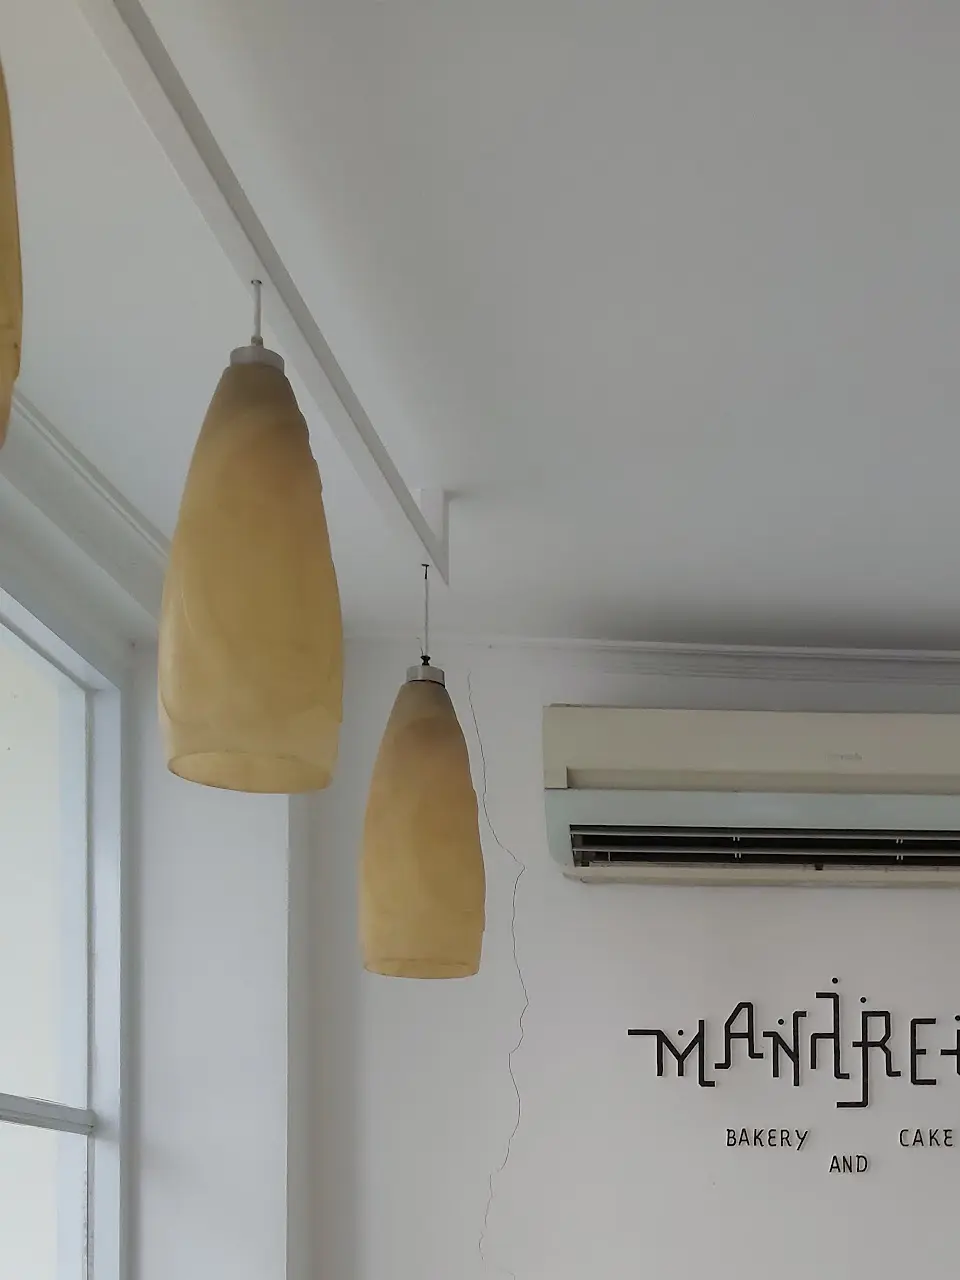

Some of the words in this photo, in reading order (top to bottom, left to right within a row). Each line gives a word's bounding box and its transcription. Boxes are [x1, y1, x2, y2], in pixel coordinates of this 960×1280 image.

[726, 1128, 809, 1151] BAKERY
[828, 1155, 869, 1173] AND
[899, 1128, 954, 1148] CAKE
